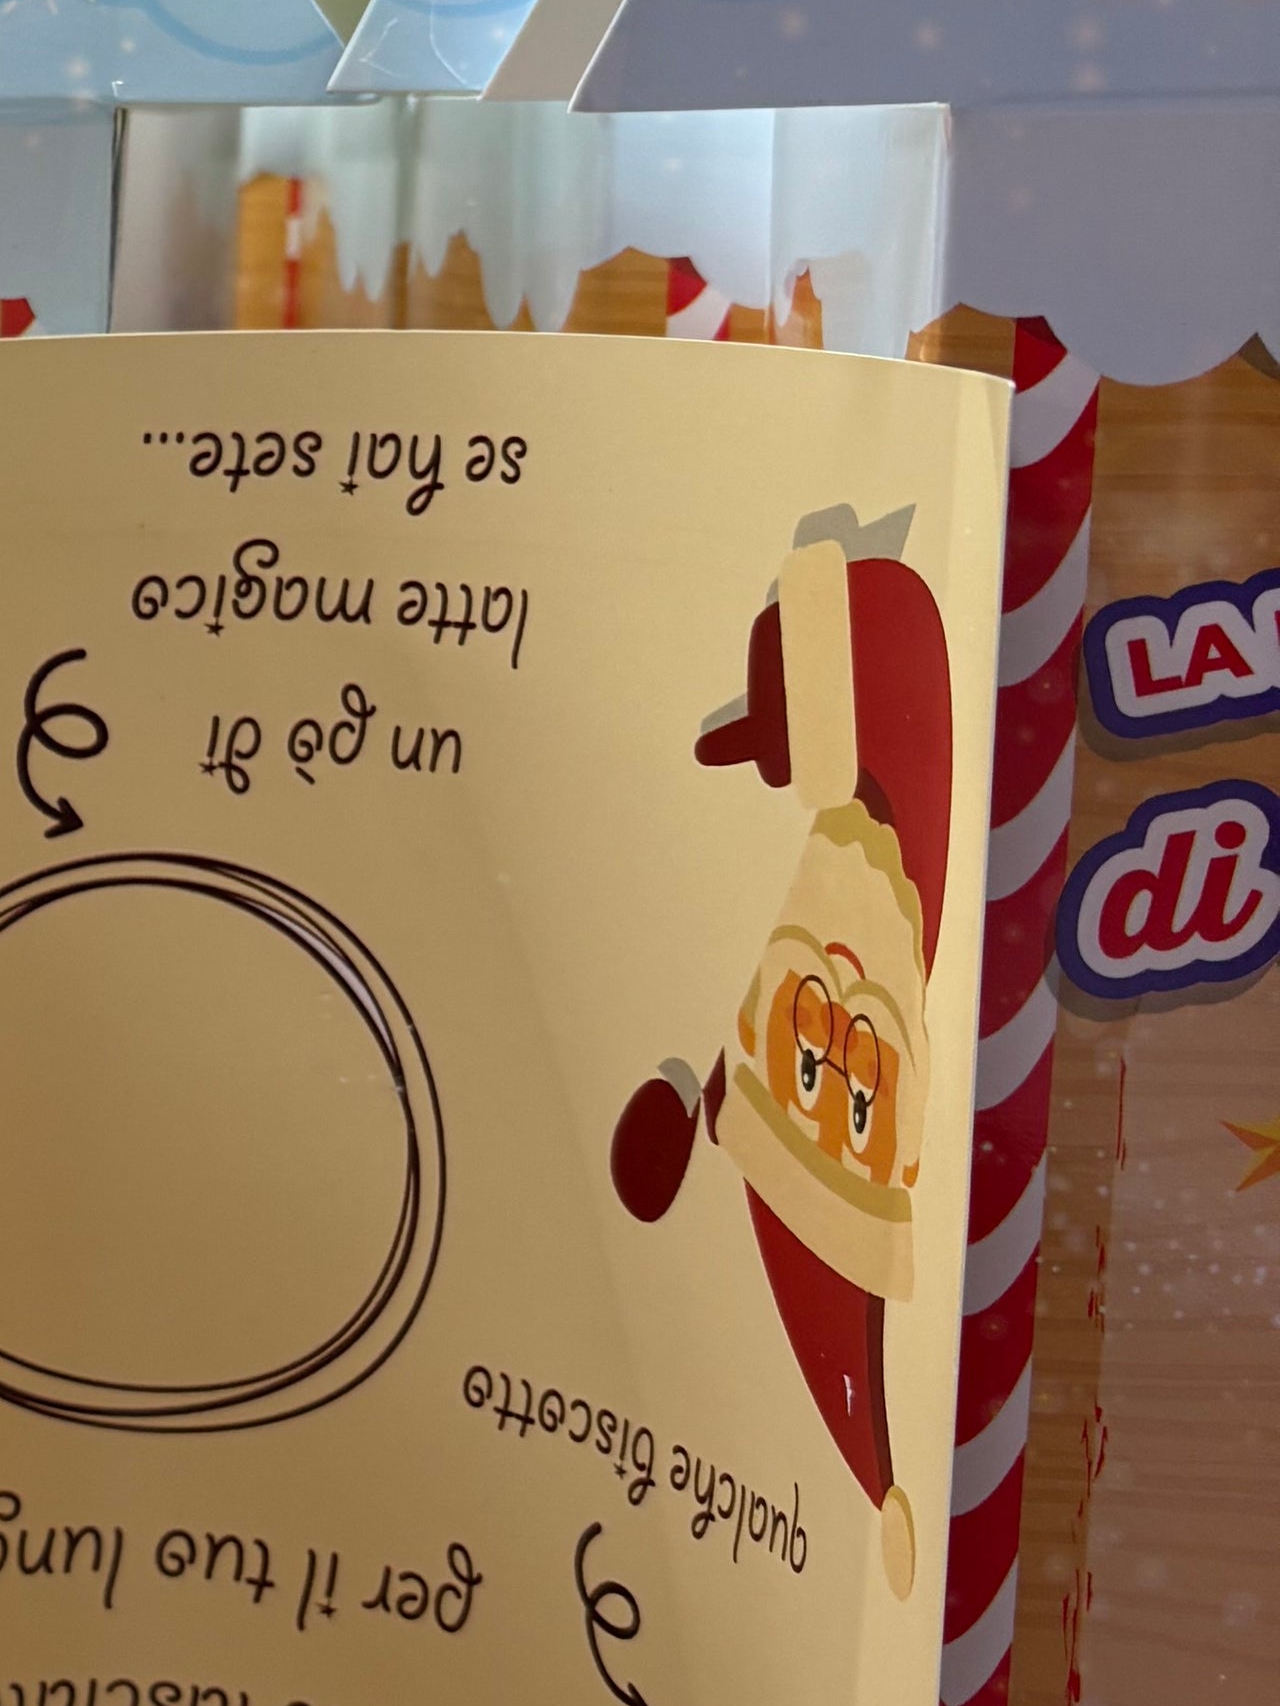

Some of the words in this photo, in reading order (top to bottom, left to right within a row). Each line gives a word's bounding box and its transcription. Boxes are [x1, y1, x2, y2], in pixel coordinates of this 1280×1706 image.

[339, 430, 445, 516] hai
[464, 434, 528, 485] se
[131, 537, 375, 639] magico
[396, 579, 529, 671] latte
[1127, 622, 1254, 698] LA
[198, 714, 262, 795] di
[287, 681, 377, 786] pò
[391, 724, 463, 775] un
[1098, 819, 1265, 961] di
[463, 1364, 657, 1507] biscotto
[669, 1443, 808, 1574] qualche
[154, 1528, 276, 1601] tuo
[297, 1551, 340, 1631] il
[360, 1543, 483, 1635] per
